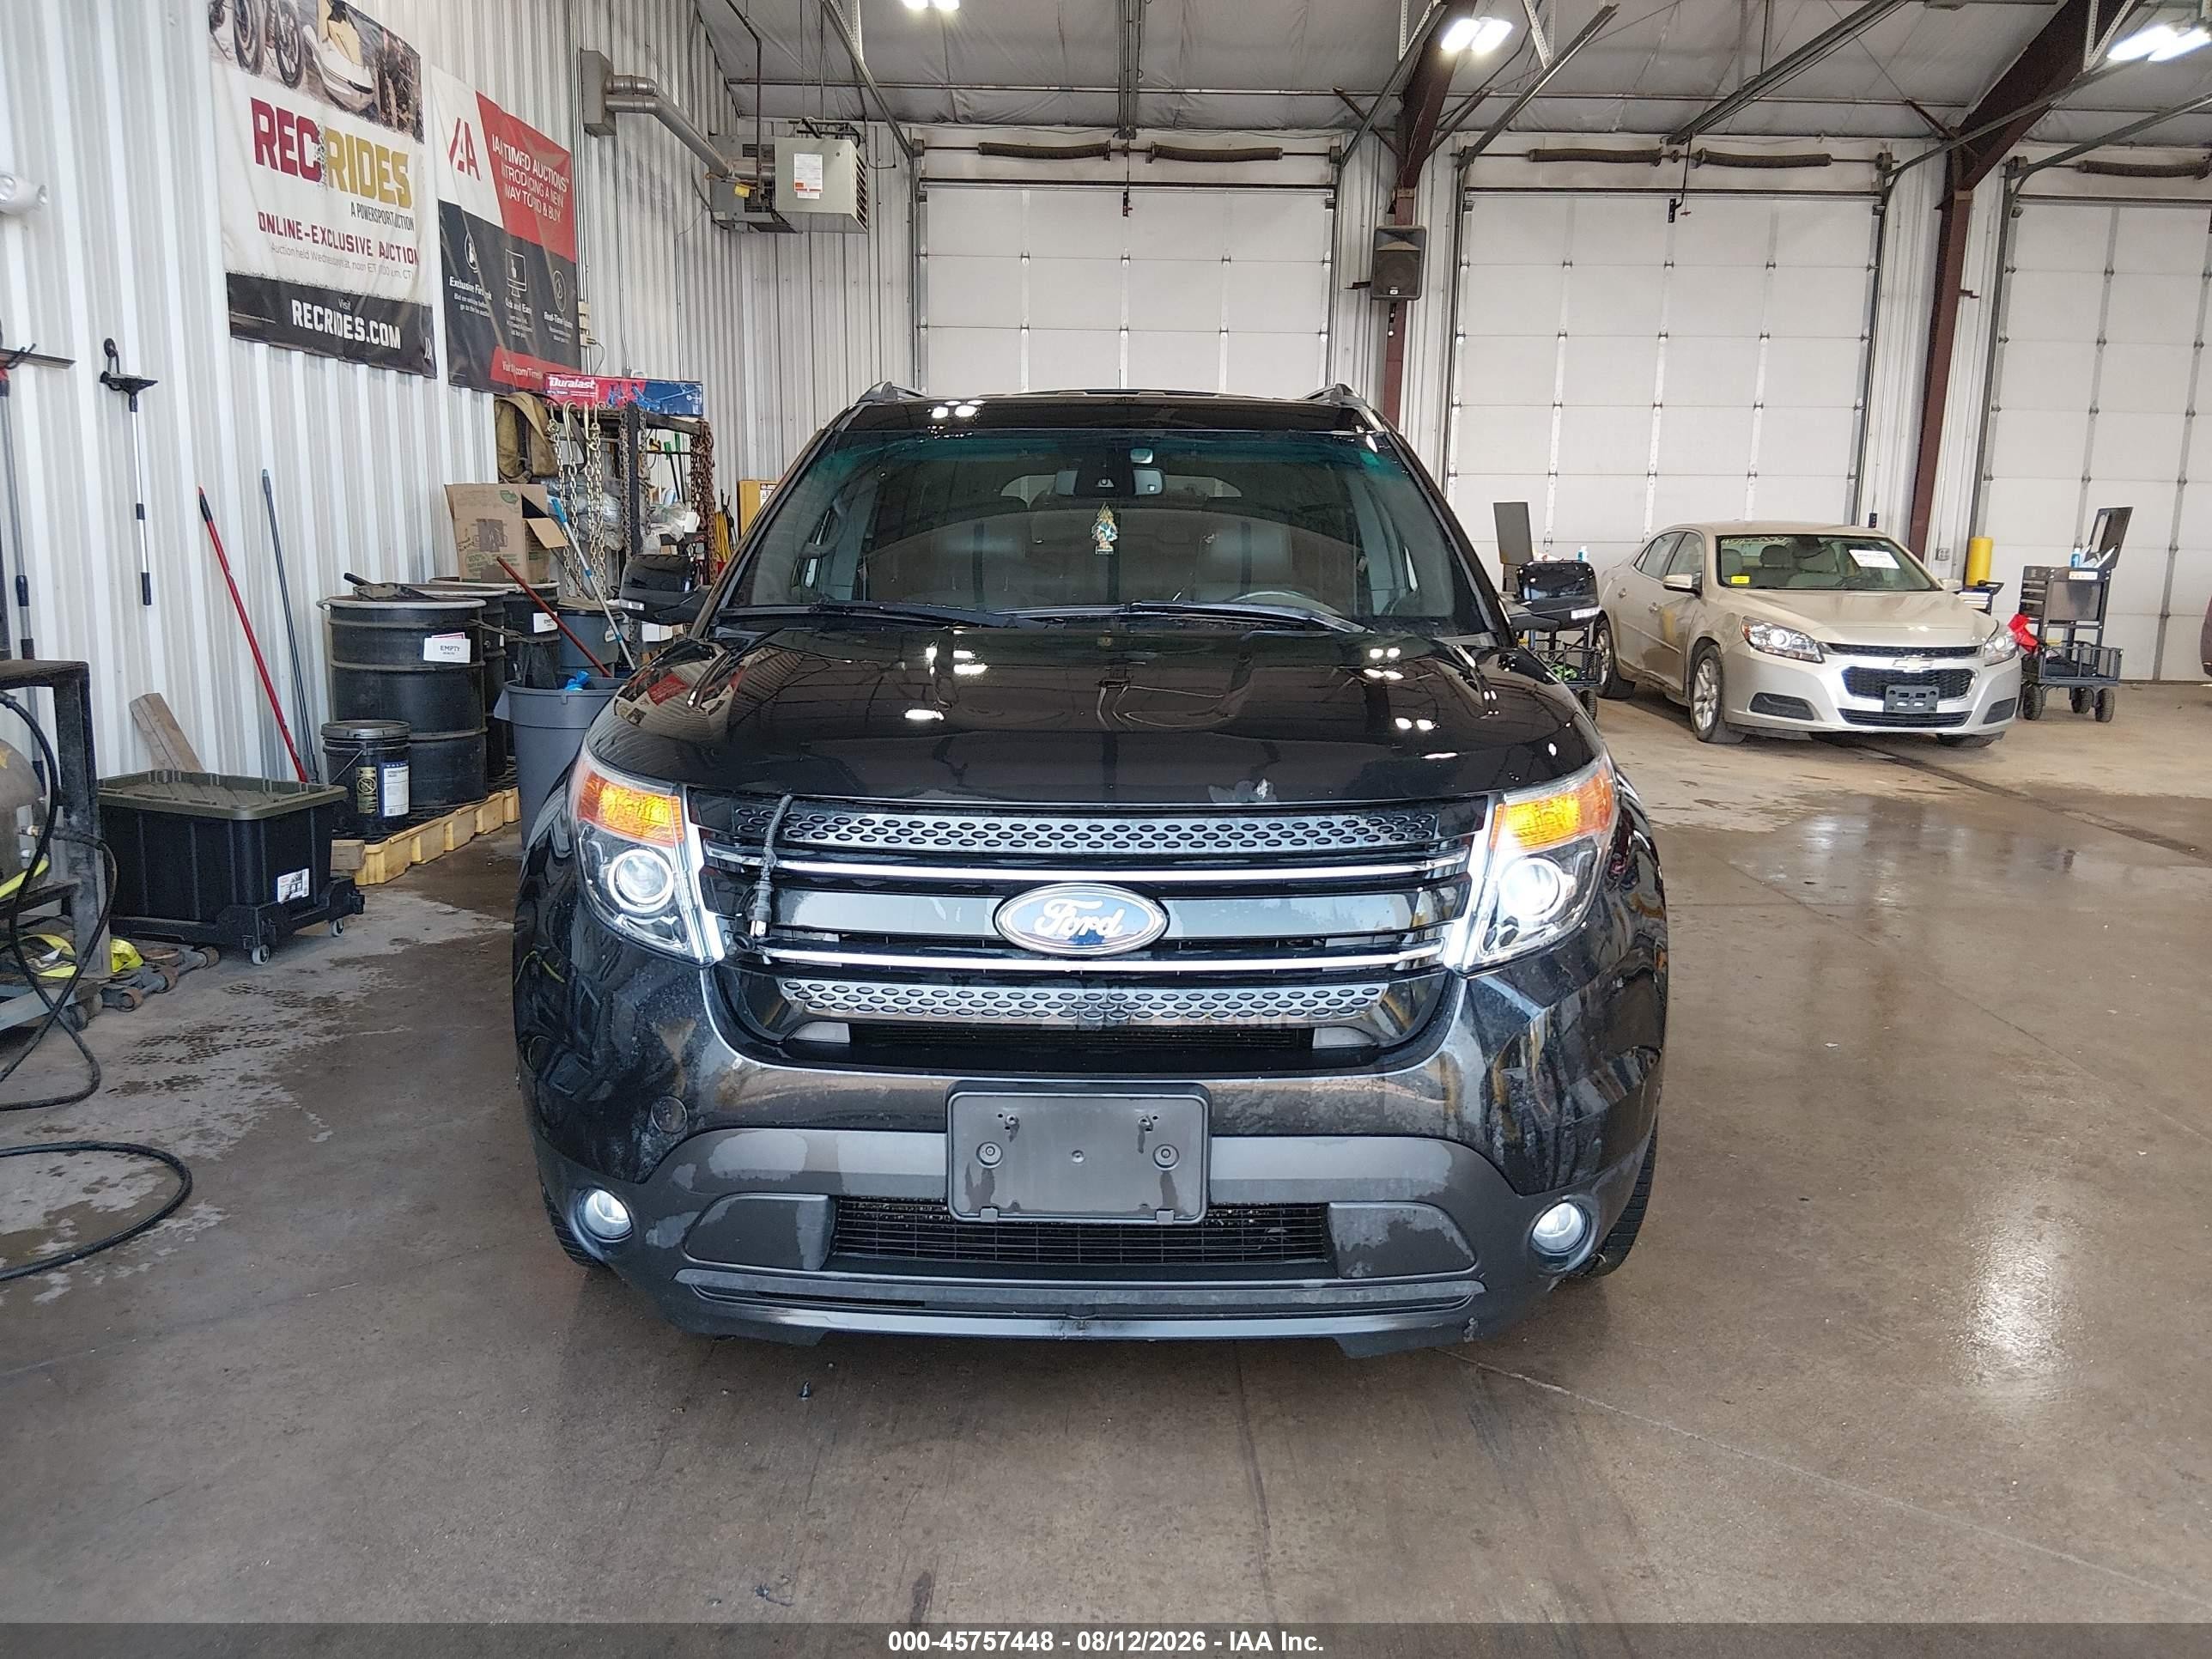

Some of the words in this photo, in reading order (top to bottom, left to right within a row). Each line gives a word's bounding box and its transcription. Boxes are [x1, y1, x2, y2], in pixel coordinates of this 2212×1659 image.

[258, 210, 373, 257] ONLINE-EXCLUSIVE
[337, 297, 351, 310] Visit
[291, 299, 401, 349] RECRIDES.COM
[548, 377, 597, 390] Duralast
[1034, 898, 1127, 937] Ford
